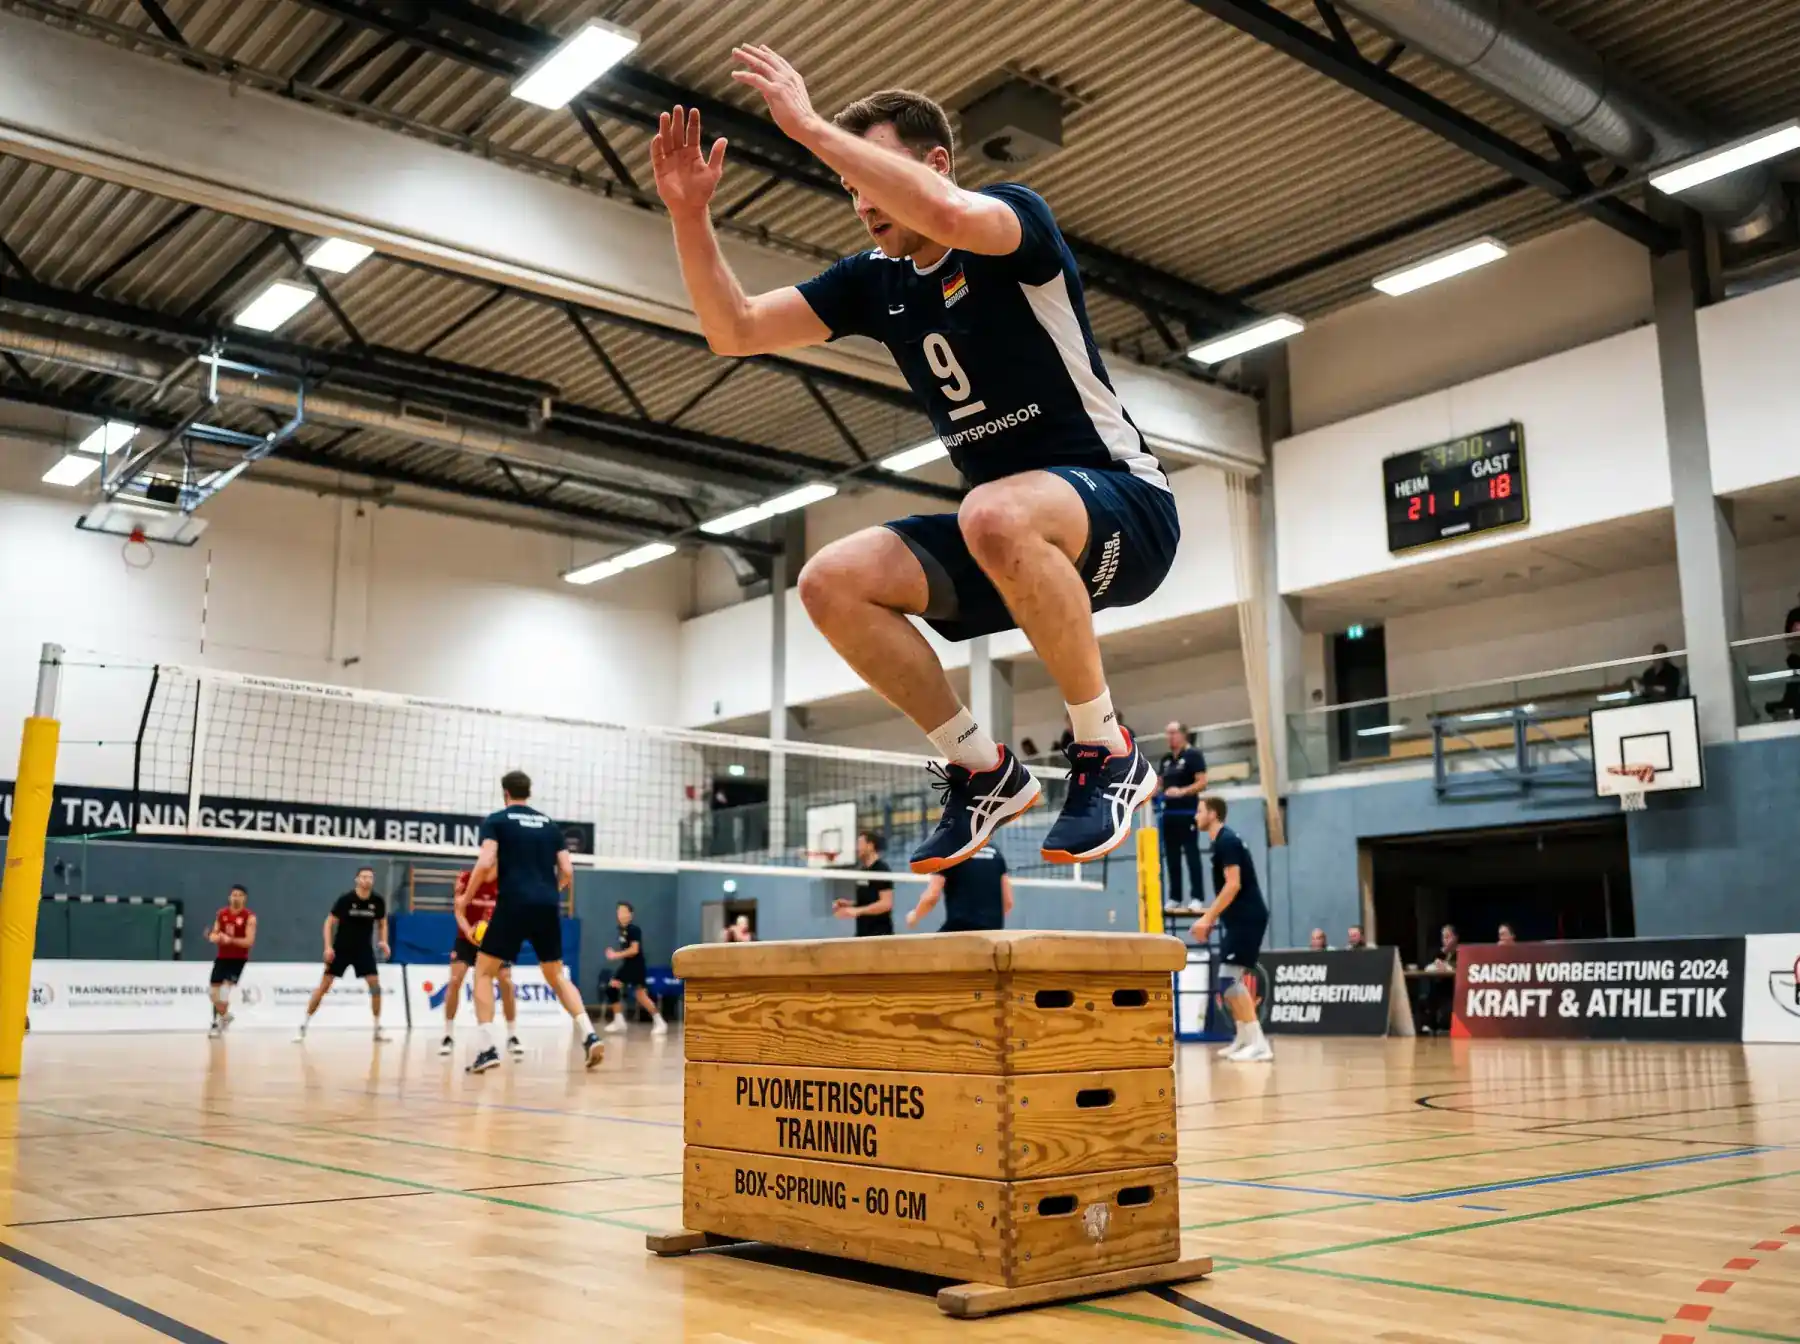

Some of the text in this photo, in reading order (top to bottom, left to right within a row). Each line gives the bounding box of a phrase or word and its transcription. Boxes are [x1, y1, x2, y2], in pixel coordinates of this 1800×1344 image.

[922, 332, 971, 402] 9
[1471, 454, 1510, 478] GAST
[1395, 475, 1429, 498] HEIM
[1408, 492, 1436, 521] 21
[1489, 473, 1511, 499] 18
[61, 797, 377, 841] TRAININGSZENTRUM
[384, 819, 480, 848] BERLIN
[1275, 965, 1327, 983] SAISON
[1467, 958, 1729, 984] SAISON VORBEREITUNG 2024
[1270, 1005, 1321, 1023] BERLIN
[1466, 987, 1728, 1018] KRAFT & ATHLETIK
[736, 1076, 925, 1120] PLYOMETRISCHES
[775, 1117, 878, 1158] TRAINING
[735, 1168, 847, 1210] BOX-SPRUNG
[866, 1186, 889, 1216] 60
[895, 1189, 927, 1221] CM
